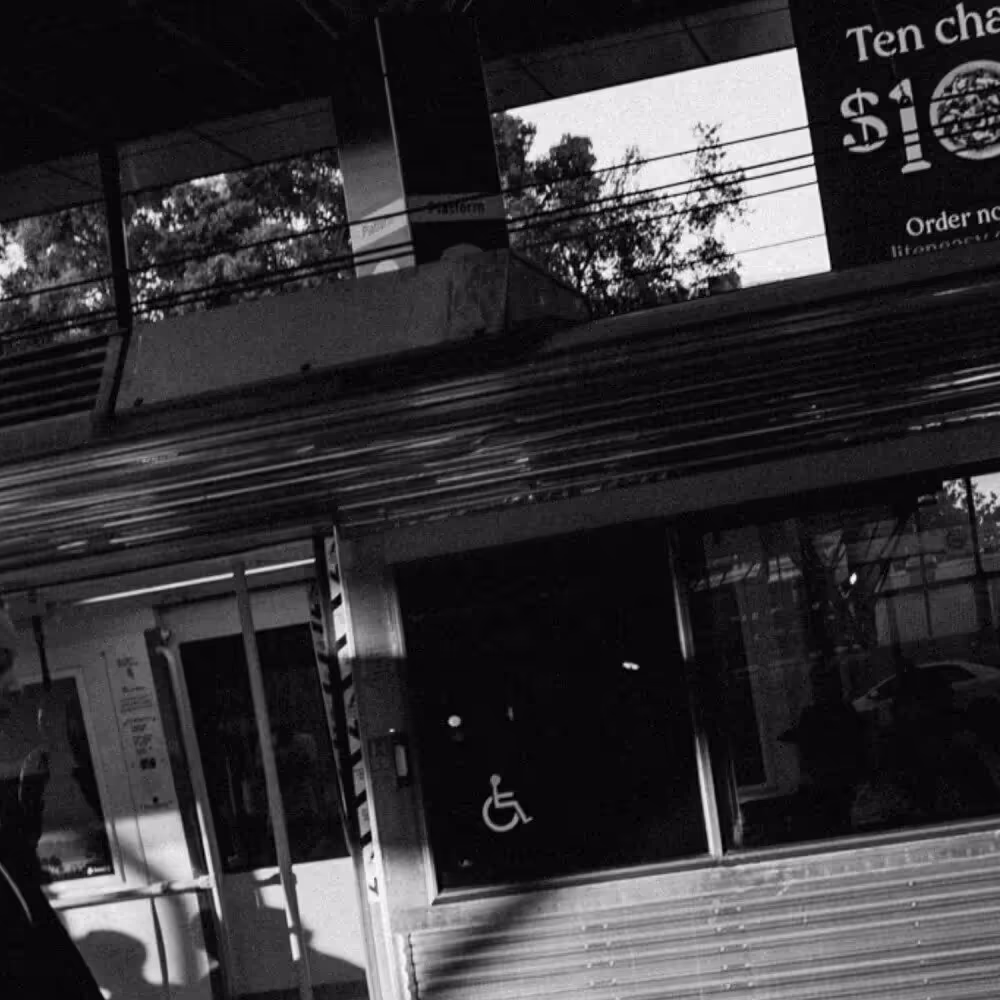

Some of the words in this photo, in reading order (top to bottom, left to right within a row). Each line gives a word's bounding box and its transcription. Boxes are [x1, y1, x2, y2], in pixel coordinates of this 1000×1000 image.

[846, 24, 925, 62] Ten
[935, 2, 1000, 45] cha
[906, 209, 972, 237] Order
